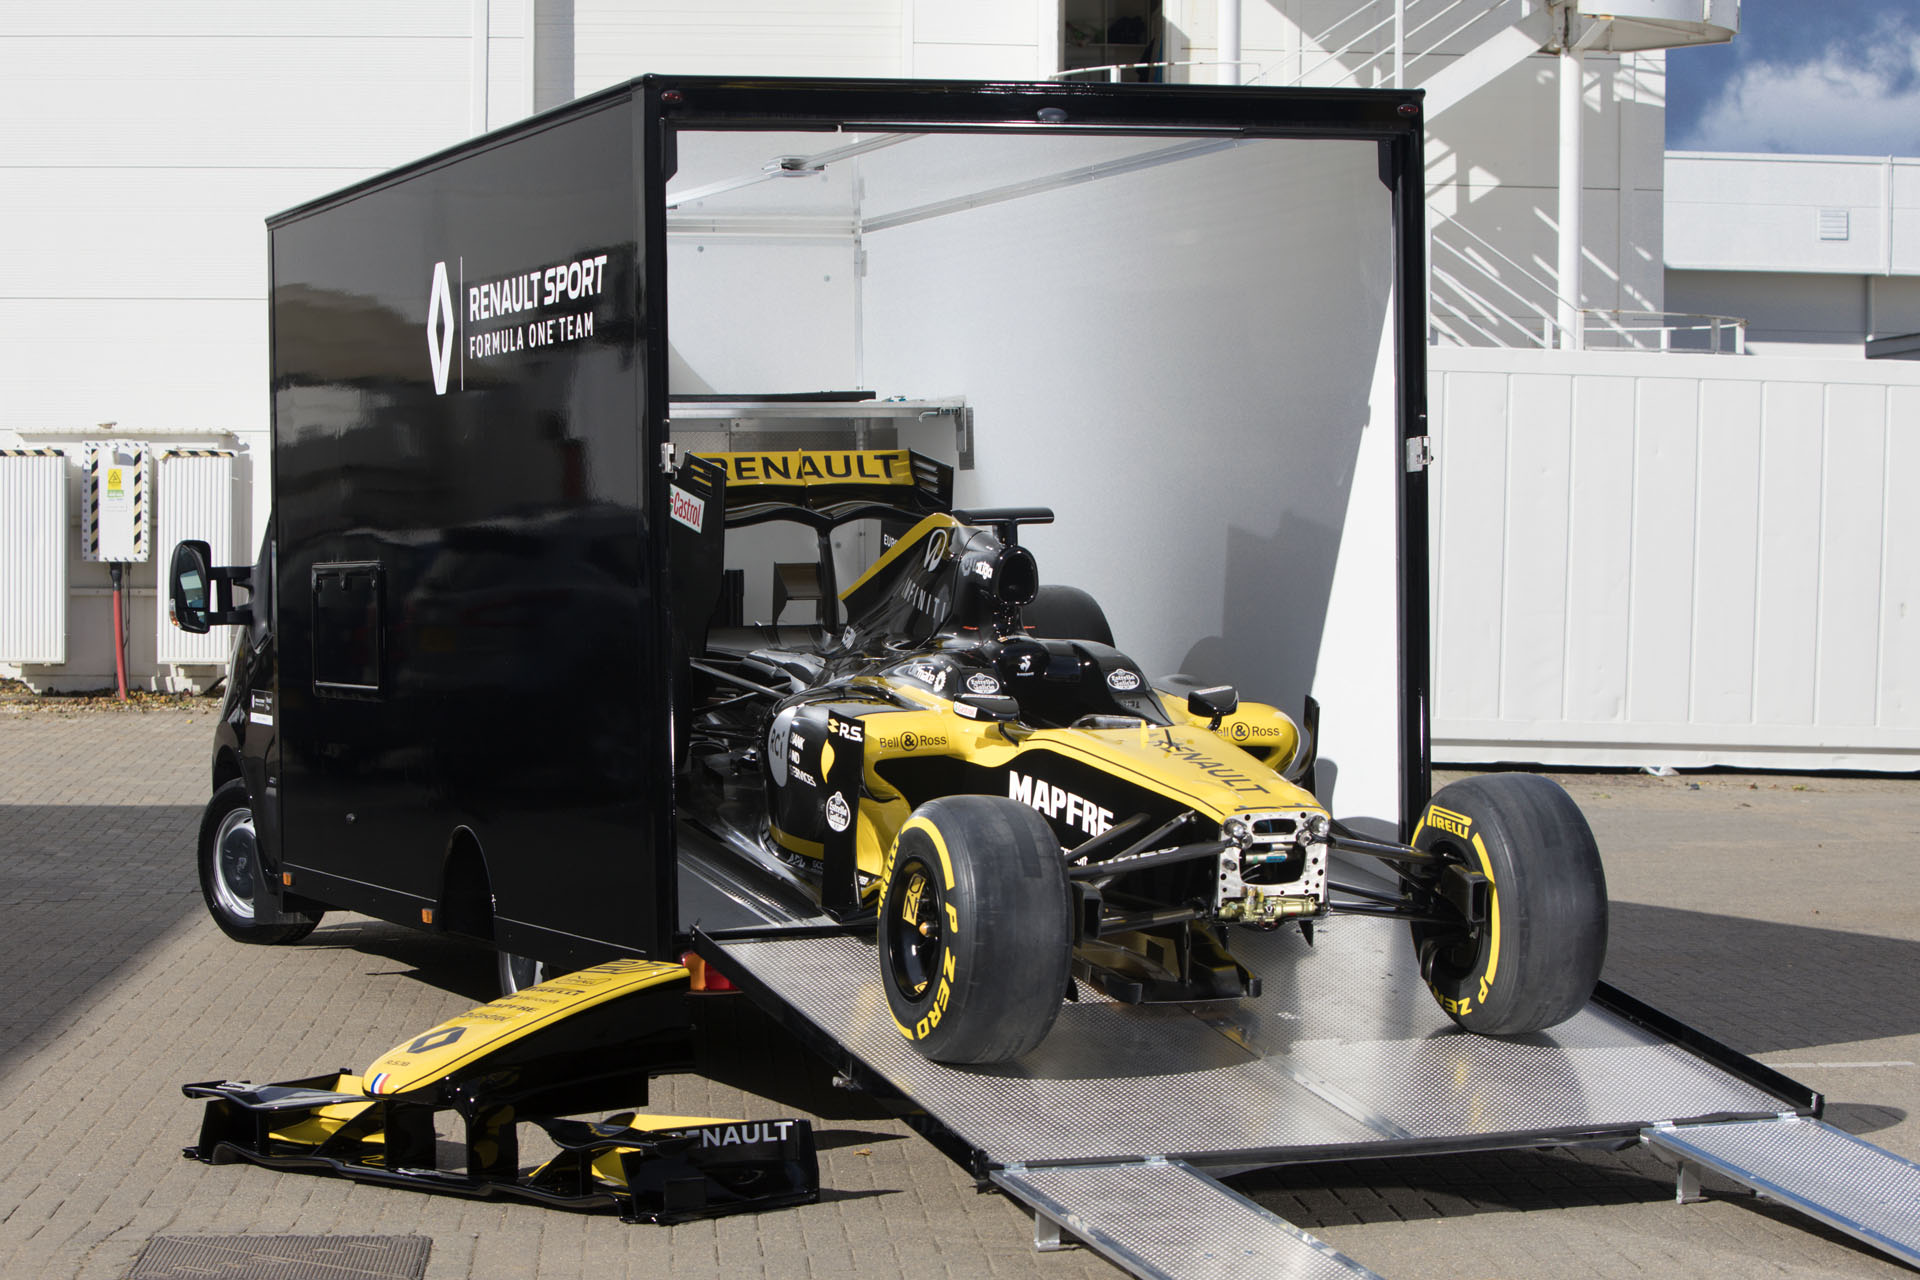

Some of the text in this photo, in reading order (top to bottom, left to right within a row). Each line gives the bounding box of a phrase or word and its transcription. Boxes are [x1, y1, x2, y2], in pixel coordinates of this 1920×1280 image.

[469, 255, 607, 322] RENAULT SPORT
[470, 311, 593, 360] FORMULA ONE TEAM
[674, 492, 702, 527] Castrol
[880, 736, 899, 748] Bell
[920, 735, 947, 746] Ross
[1216, 726, 1229, 737] ell
[1252, 726, 1280, 736] Ross
[1009, 770, 1114, 838] MAPFRE
[1427, 805, 1472, 840] PIRELLI
[917, 902, 959, 1040] P ZERO
[1430, 982, 1472, 1016] ZER
